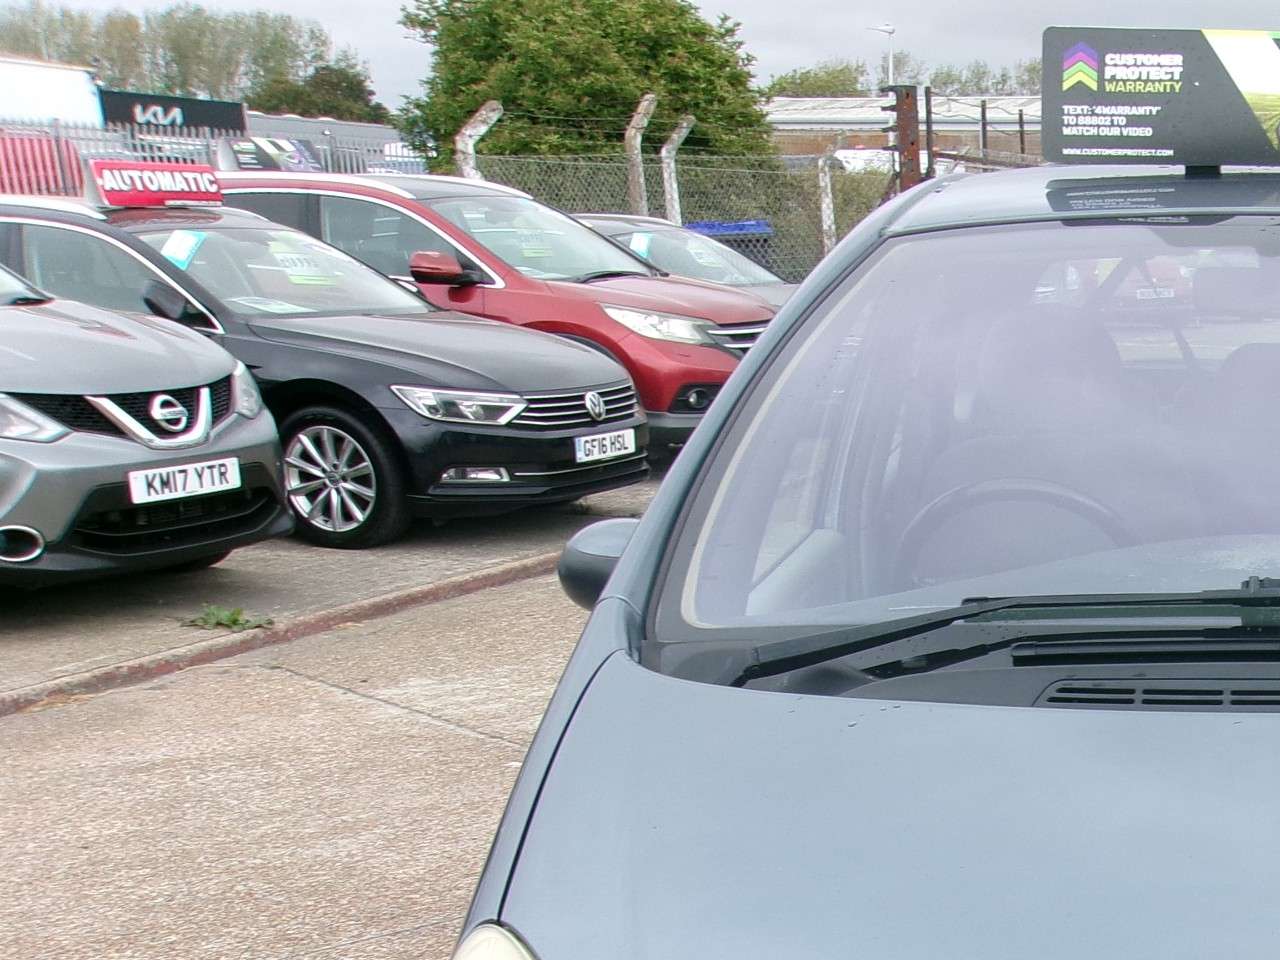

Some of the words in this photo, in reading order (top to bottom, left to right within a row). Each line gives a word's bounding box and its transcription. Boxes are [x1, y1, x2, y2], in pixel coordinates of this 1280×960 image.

[1104, 53, 1184, 66] CUSTOMER
[1104, 66, 1184, 81] PROTECT
[1104, 81, 1183, 93] WARRANTY
[1062, 105, 1091, 115] TEXT:
[1062, 116, 1077, 125] TO
[1112, 116, 1127, 126] TO
[1062, 127, 1098, 136] WATCH
[1100, 127, 1121, 136] OUR
[1122, 127, 1153, 137] VIDEO
[103, 168, 219, 193] AUTOMATIC
[583, 437, 608, 457] GF16
[609, 433, 629, 453] HSL
[145, 469, 188, 497] KM17
[194, 463, 230, 488] YTR
